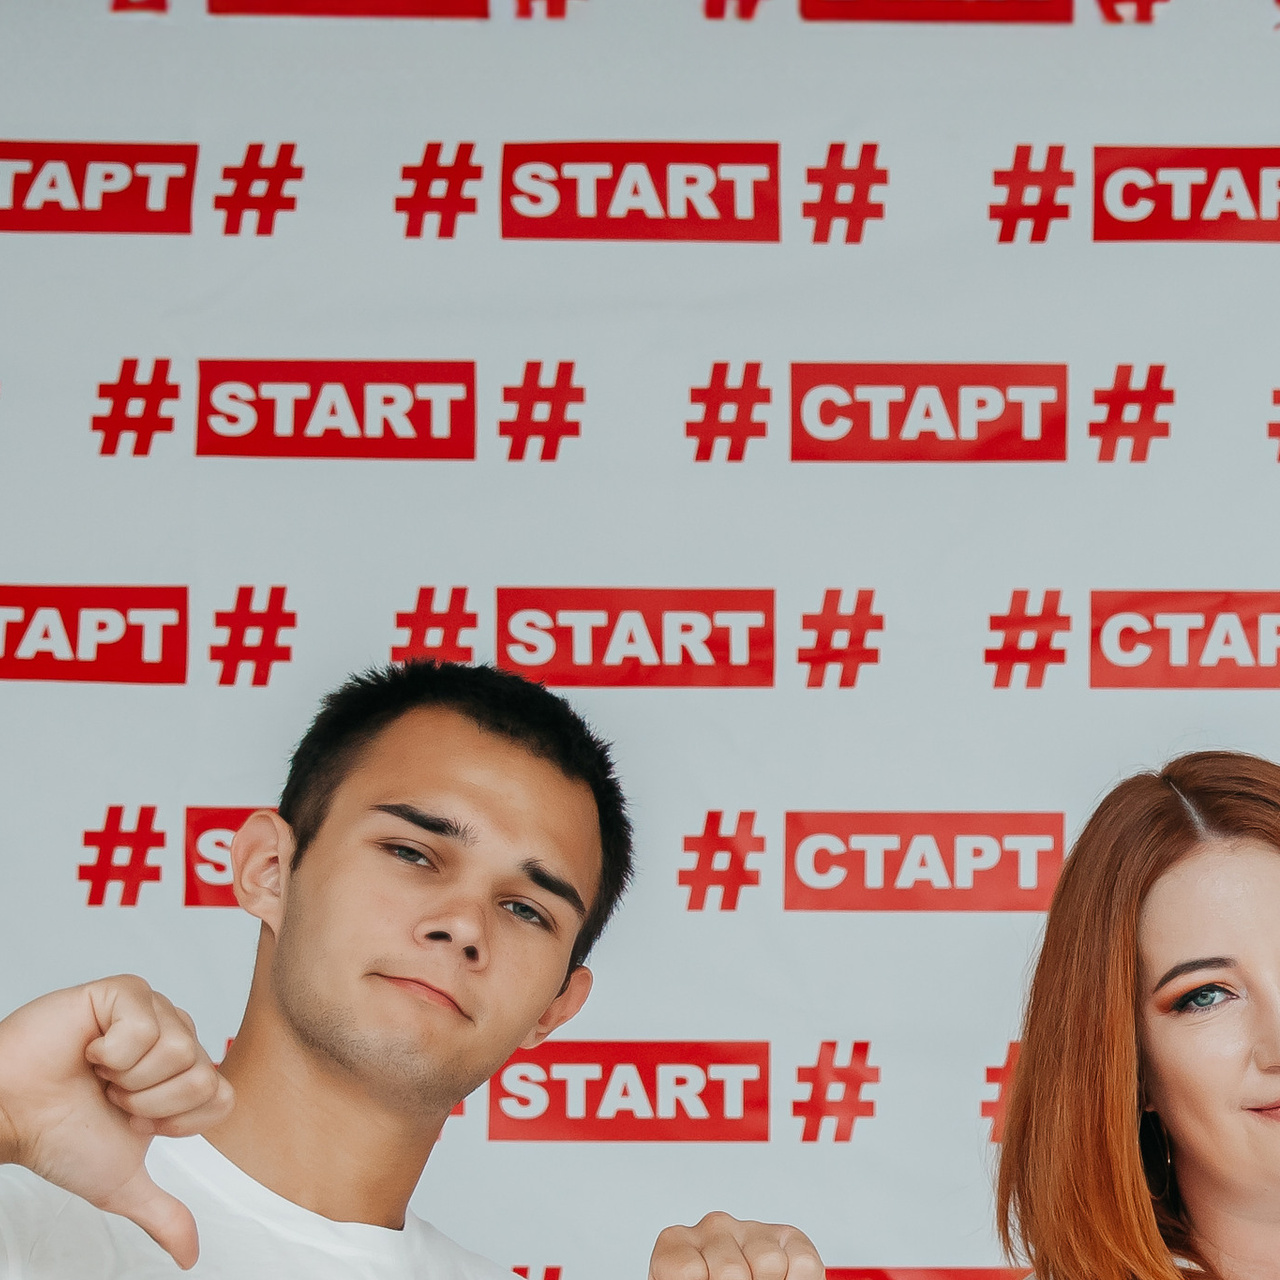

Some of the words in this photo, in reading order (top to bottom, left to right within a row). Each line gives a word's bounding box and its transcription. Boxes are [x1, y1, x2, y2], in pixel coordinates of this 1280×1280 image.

[0, 162, 186, 211] ТАРТ
[511, 162, 770, 220] START
[208, 381, 466, 439] START
[801, 384, 1058, 441] СТАРТ
[507, 609, 765, 666] START
[794, 833, 1055, 890] СТАРТ
[499, 1062, 760, 1120] START
